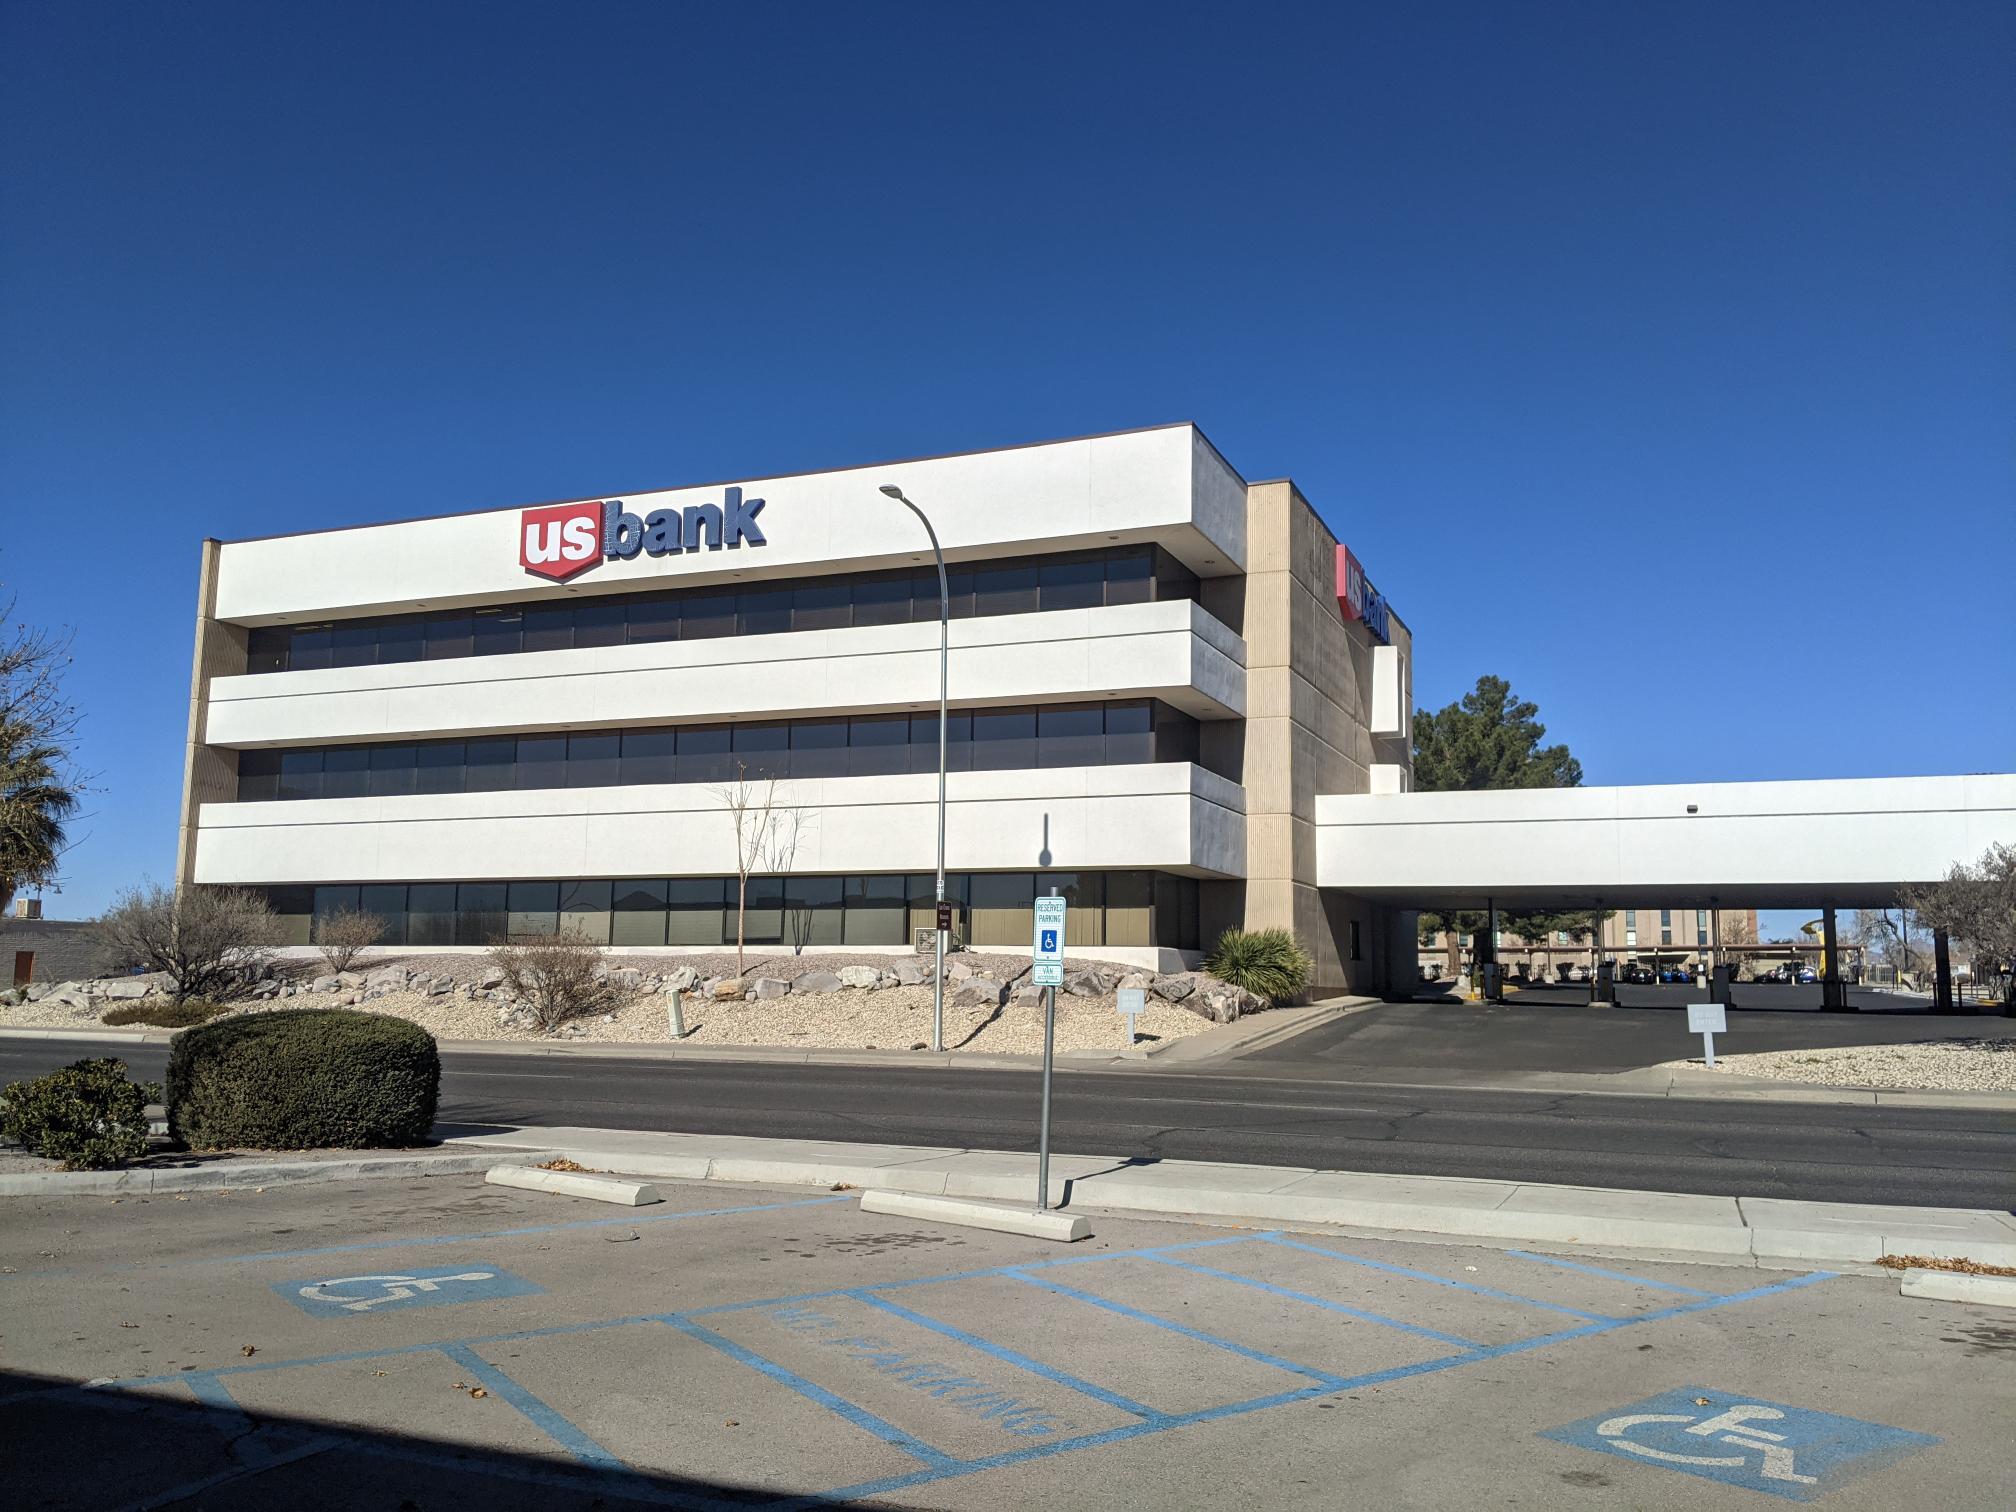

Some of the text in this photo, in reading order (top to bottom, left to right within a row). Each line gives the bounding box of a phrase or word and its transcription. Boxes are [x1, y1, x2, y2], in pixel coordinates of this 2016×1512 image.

[525, 486, 767, 565] us bank
[1037, 903, 1063, 912] RESERVED
[1038, 914, 1061, 922] PARKING
[1042, 967, 1054, 975] VAN
[822, 1335, 1058, 1437] PARKING
